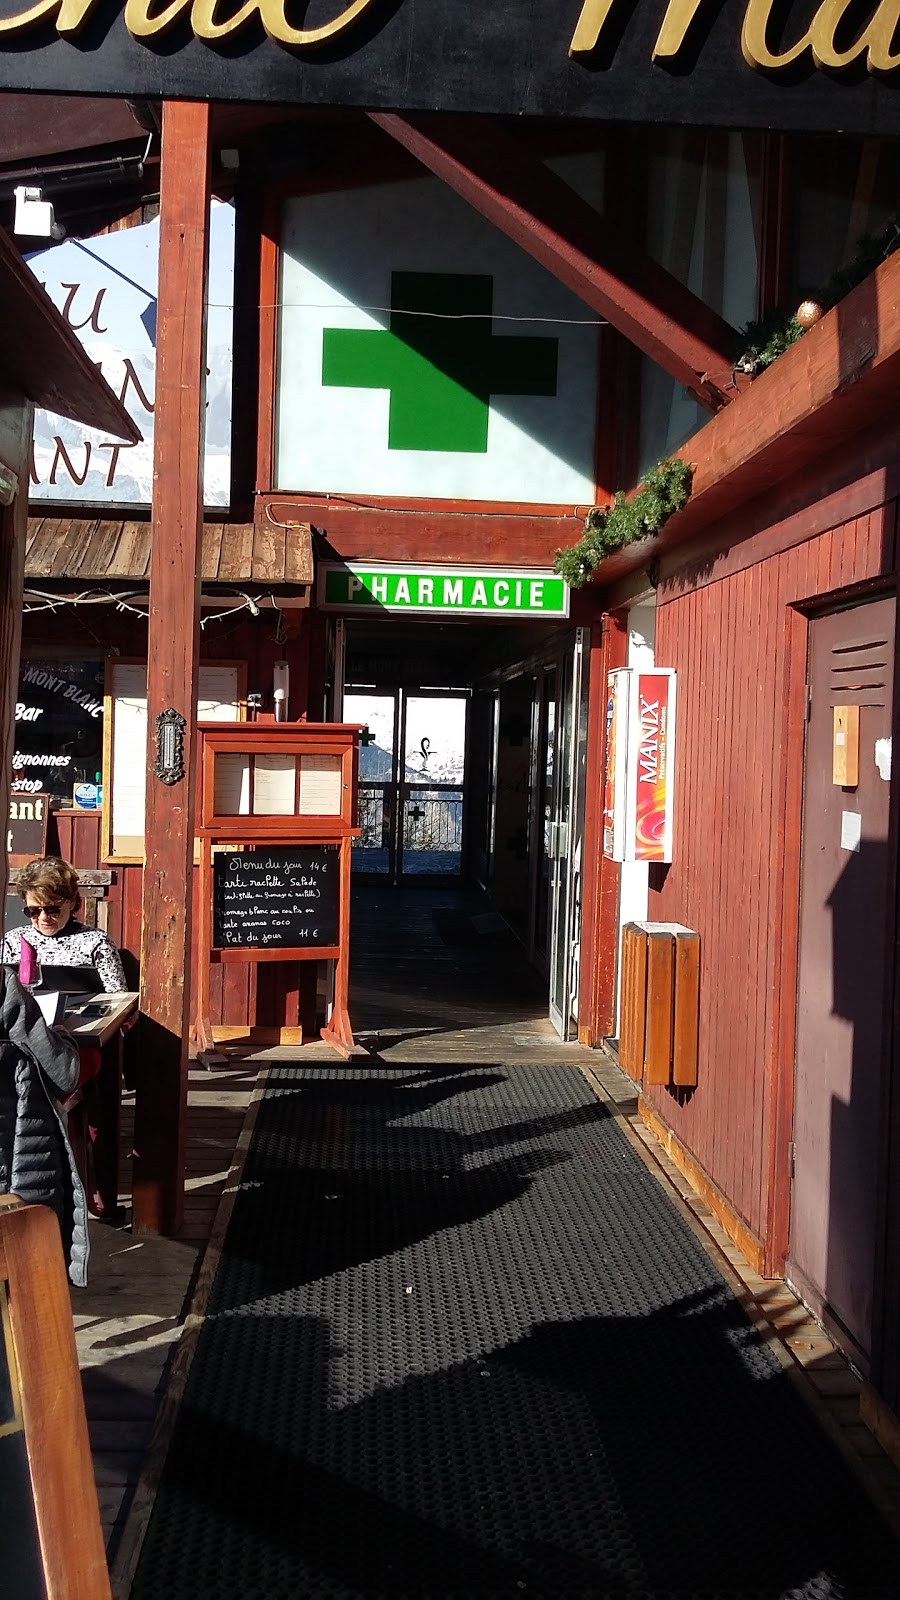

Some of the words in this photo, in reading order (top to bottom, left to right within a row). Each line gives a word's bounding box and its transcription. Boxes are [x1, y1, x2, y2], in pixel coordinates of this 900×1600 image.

[40, 282, 107, 333] U
[348, 574, 544, 608] PHARMACIE
[22, 667, 67, 693] MONT
[62, 683, 105, 719] BLANC
[15, 703, 43, 722] Bar
[659, 706, 668, 736] Condoms
[639, 700, 660, 784] MANIX
[11, 751, 71, 770] ignonnes
[658, 742, 667, 780] Préservatifs
[11, 777, 43, 794] -stop
[9, 799, 44, 821] ant
[229, 857, 264, 871] Menu
[265, 857, 281, 869] du
[282, 861, 302, 874] jour
[309, 861, 320, 871] 14
[321, 863, 328, 873] €
[246, 931, 259, 942] du
[261, 931, 282, 944] jour
[298, 928, 309, 938] 11
[312, 928, 319, 938] €
